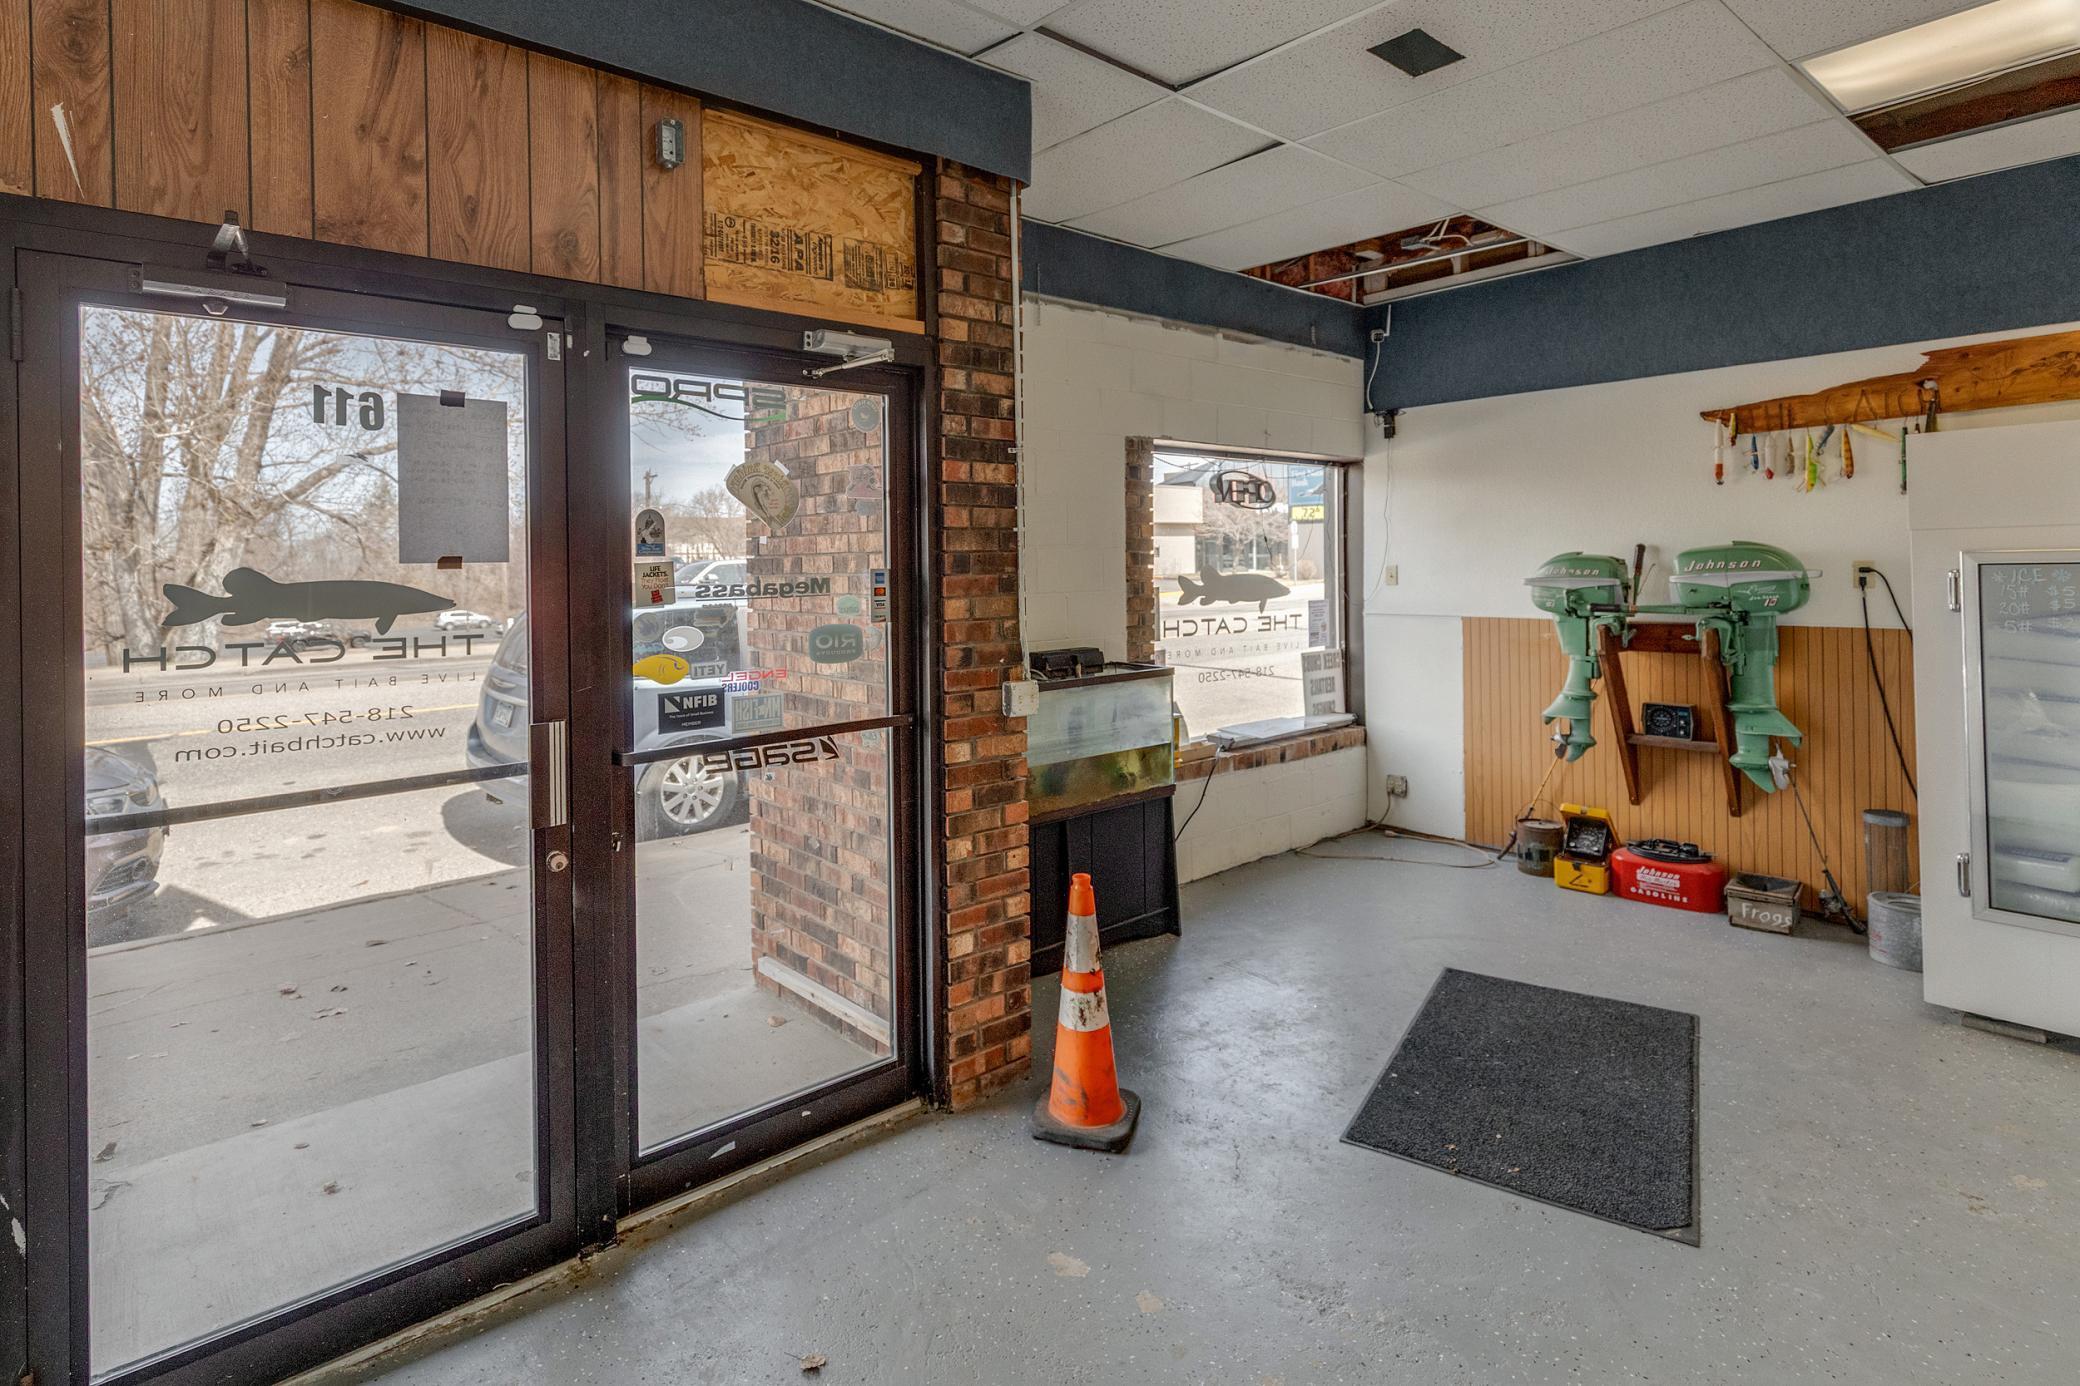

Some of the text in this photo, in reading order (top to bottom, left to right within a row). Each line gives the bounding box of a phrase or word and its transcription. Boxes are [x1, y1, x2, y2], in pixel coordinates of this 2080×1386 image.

[769, 230, 780, 264] 32/16
[793, 231, 804, 272] APA
[1684, 558, 1762, 573] Johnson
[2010, 567, 2048, 583] ICE
[683, 694, 718, 709] NFIB
[1635, 865, 1681, 880] Johnson
[1630, 886, 1689, 904] GASOLINE
[1741, 901, 1793, 929] Frogs
